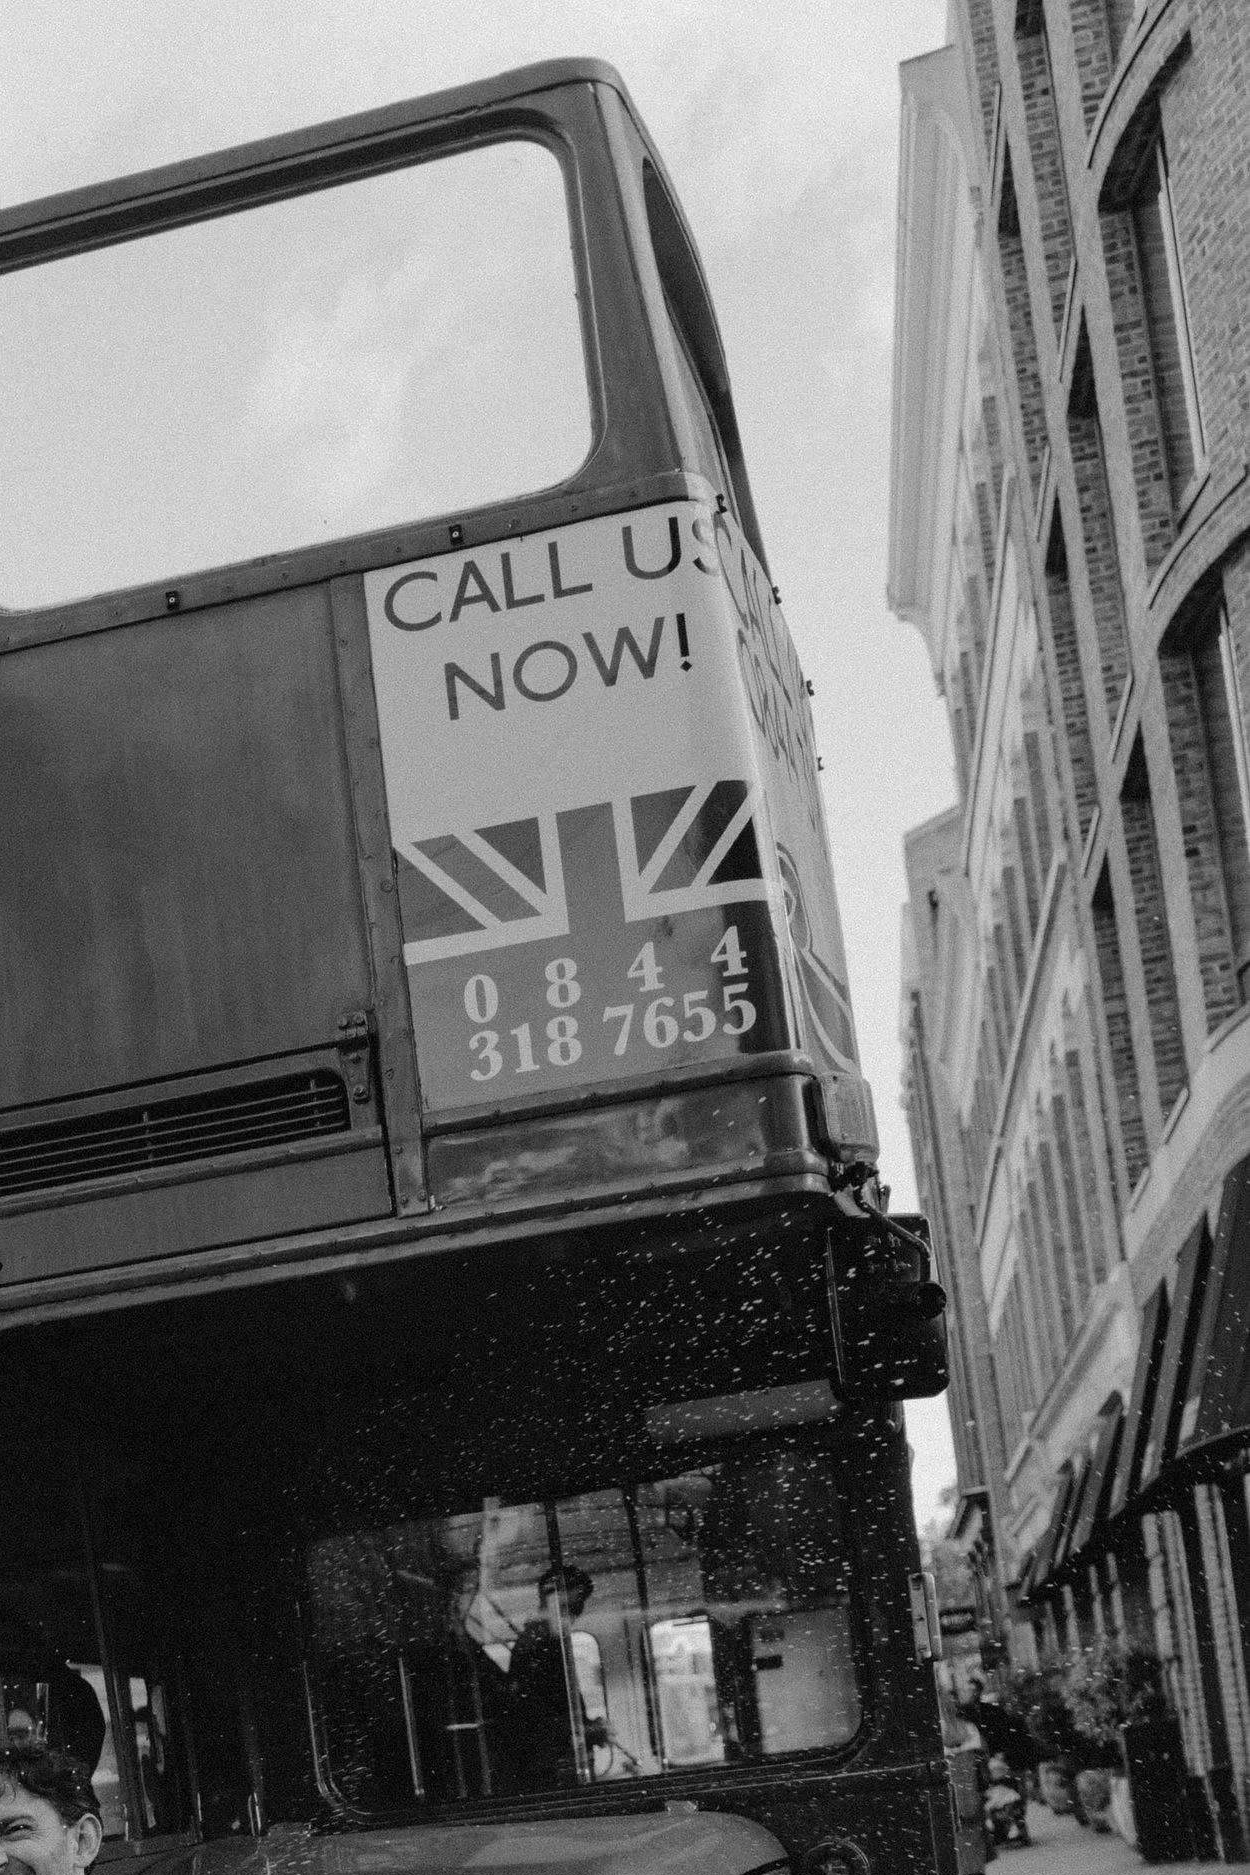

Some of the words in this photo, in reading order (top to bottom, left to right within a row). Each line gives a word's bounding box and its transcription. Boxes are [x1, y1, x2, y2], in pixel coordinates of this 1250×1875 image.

[383, 541, 594, 632] CALL
[444, 613, 693, 720] NOW!
[469, 1015, 583, 1082] 318
[602, 982, 758, 1057] 7655
